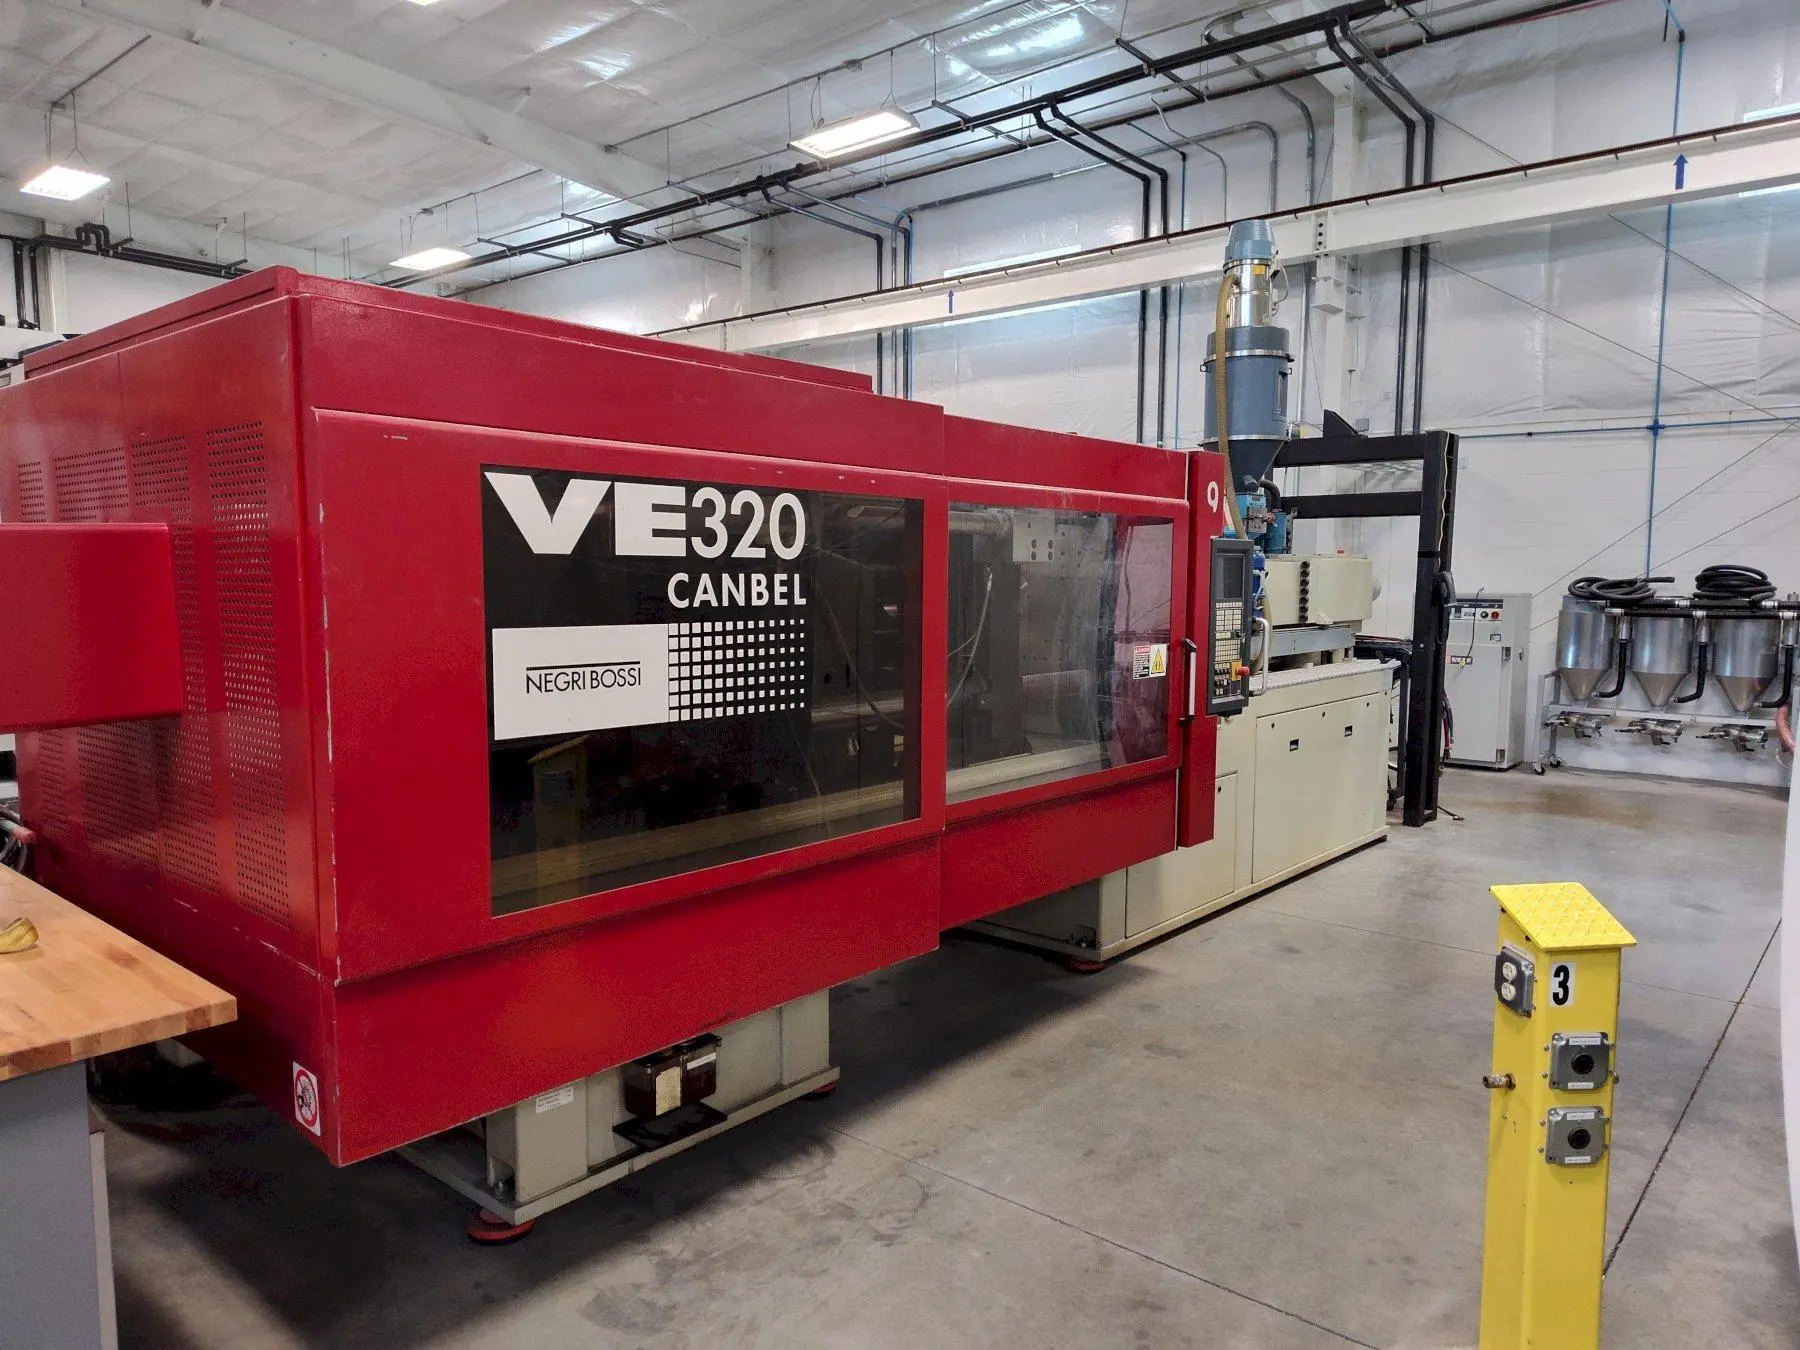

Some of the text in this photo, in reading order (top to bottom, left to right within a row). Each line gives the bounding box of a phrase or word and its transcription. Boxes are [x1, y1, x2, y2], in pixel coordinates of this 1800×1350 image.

[484, 471, 806, 560] VE320
[667, 573, 807, 608] CANBEL
[526, 667, 641, 694] NEGRI BOSSI
[1553, 964, 1570, 1006] 3
